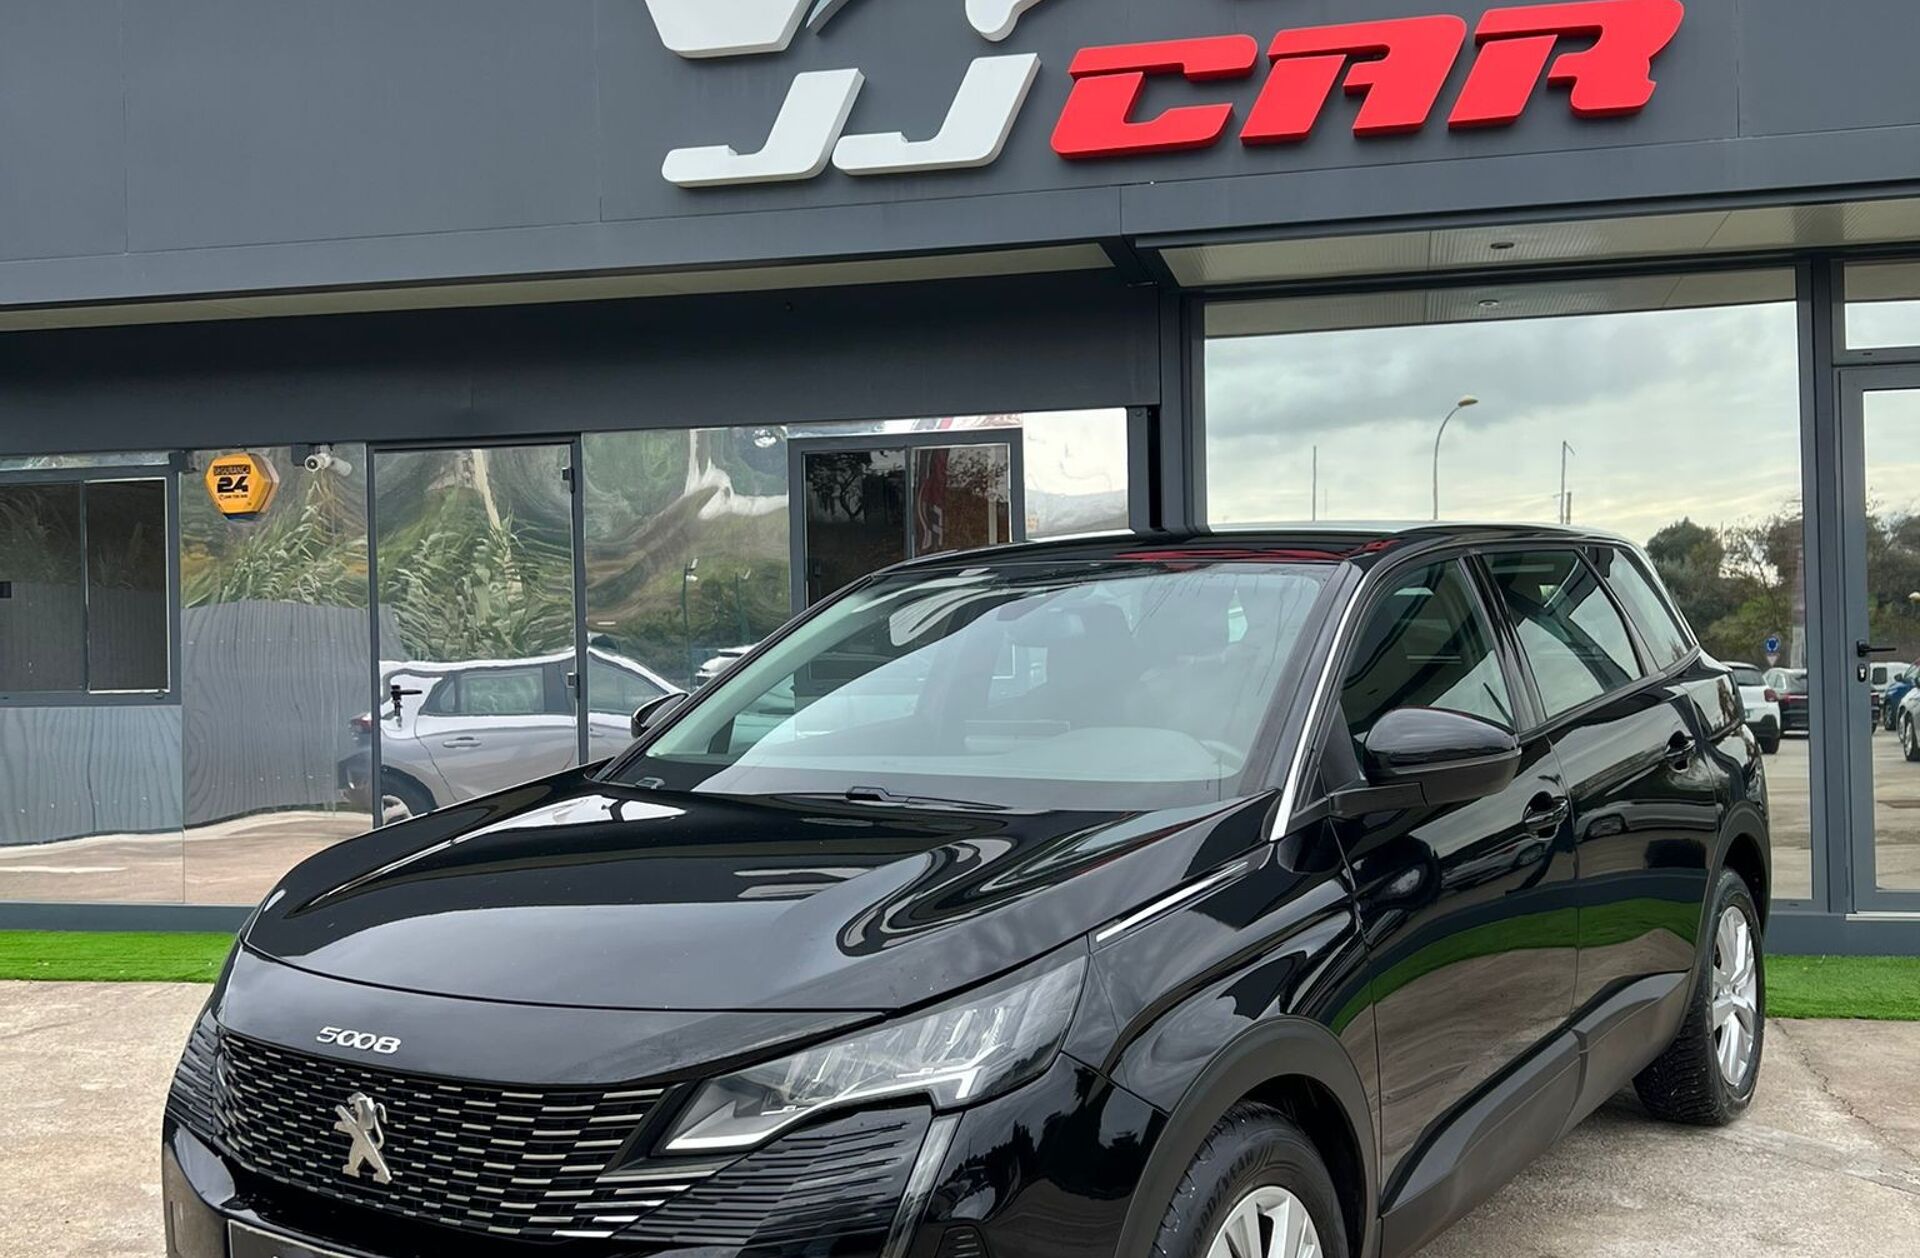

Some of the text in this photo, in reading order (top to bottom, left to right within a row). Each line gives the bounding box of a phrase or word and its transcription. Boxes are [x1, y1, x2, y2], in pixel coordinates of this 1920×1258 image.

[662, 0, 1685, 188] JJ CAR
[217, 476, 249, 493] 24
[316, 1027, 401, 1055] 5008
